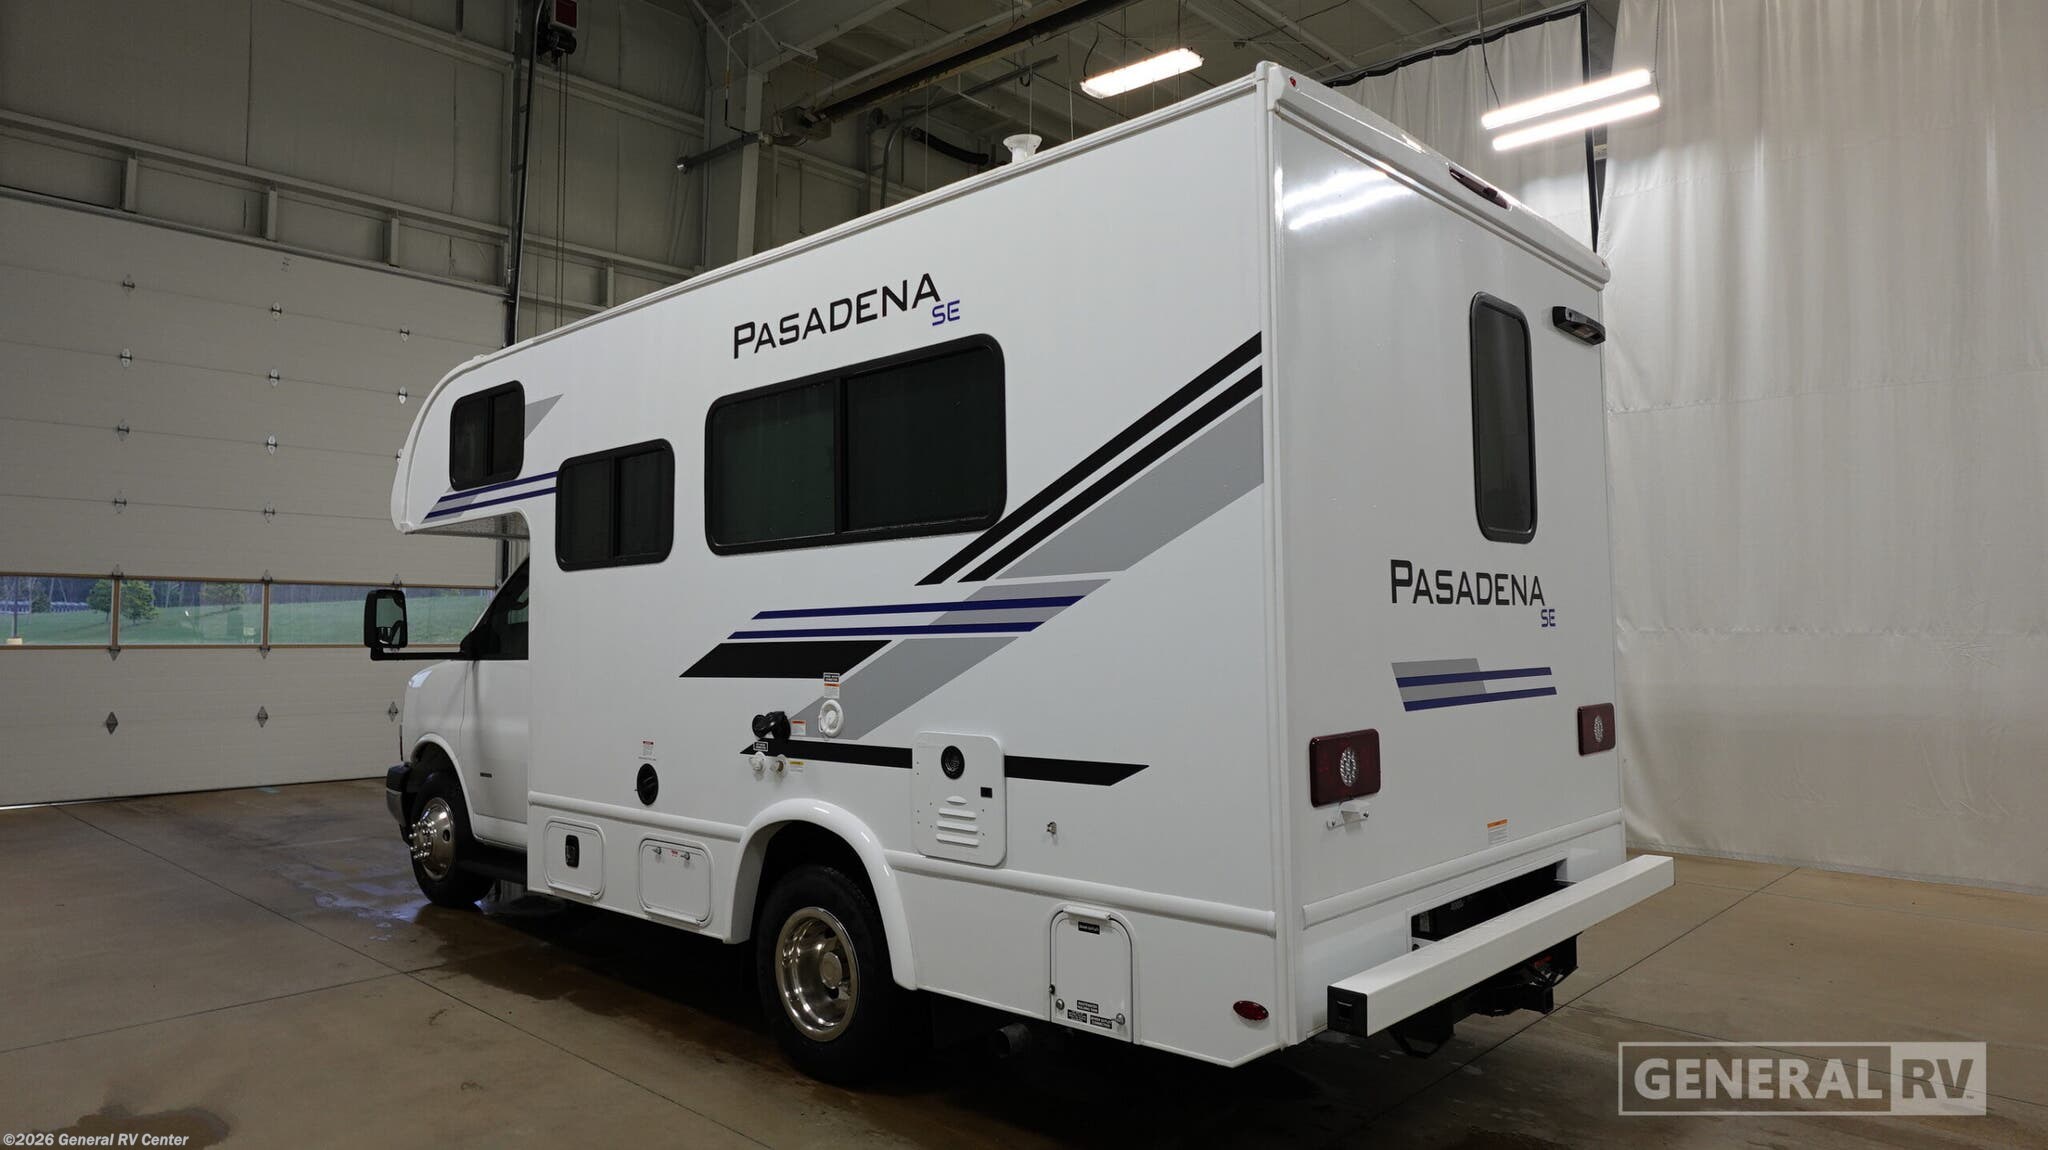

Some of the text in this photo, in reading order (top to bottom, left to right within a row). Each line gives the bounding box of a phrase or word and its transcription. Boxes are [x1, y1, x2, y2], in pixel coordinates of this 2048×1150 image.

[733, 273, 941, 359] PASADENA
[931, 300, 961, 326] SE
[1390, 559, 1545, 606] PASADENA
[1540, 608, 1556, 627] SE
